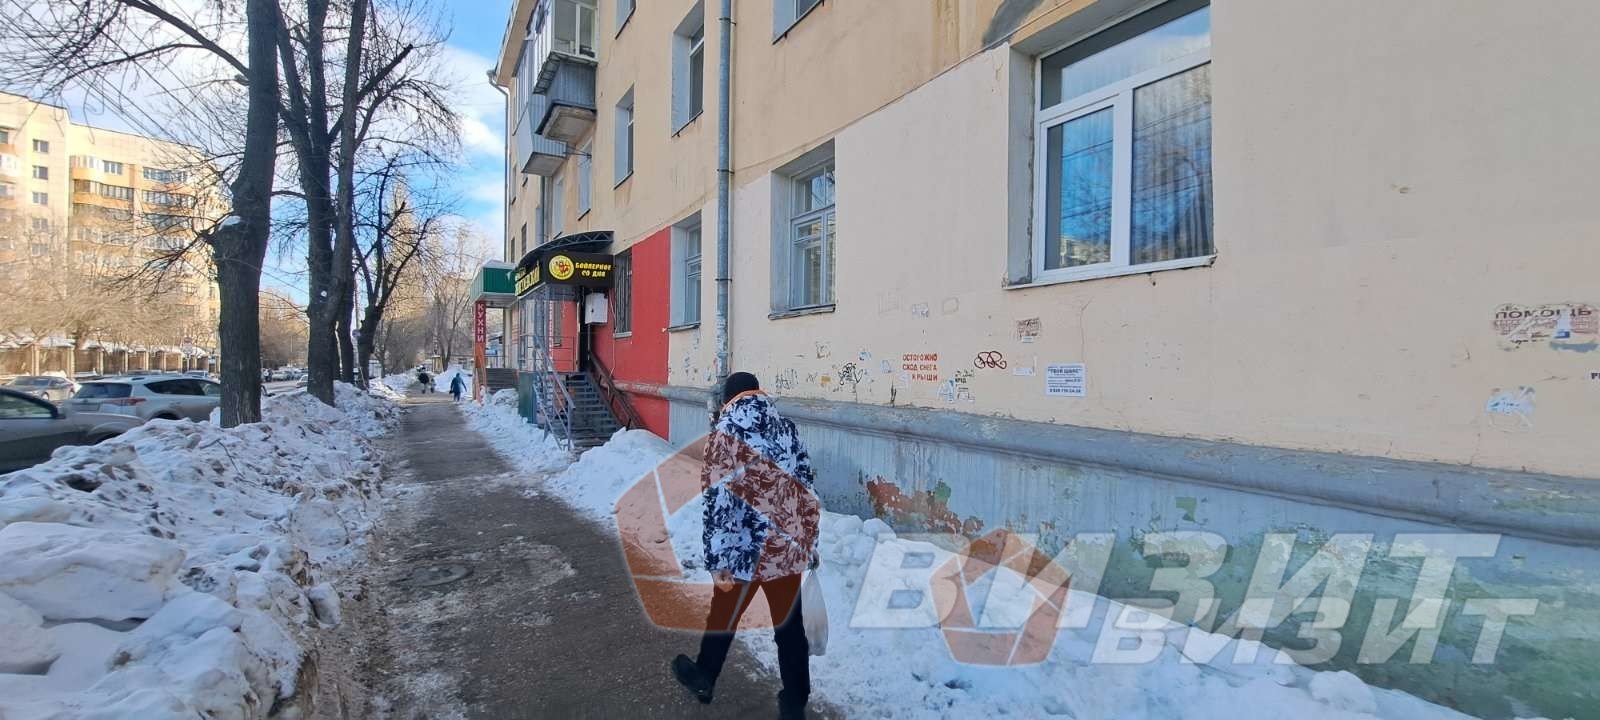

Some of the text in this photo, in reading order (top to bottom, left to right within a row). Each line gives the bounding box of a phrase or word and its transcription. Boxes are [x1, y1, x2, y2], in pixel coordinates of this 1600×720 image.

[476, 303, 484, 342] КУХНИ
[902, 353, 938, 362] ОСТОРОЖНО
[902, 363, 938, 371] СХОД СНЕГА
